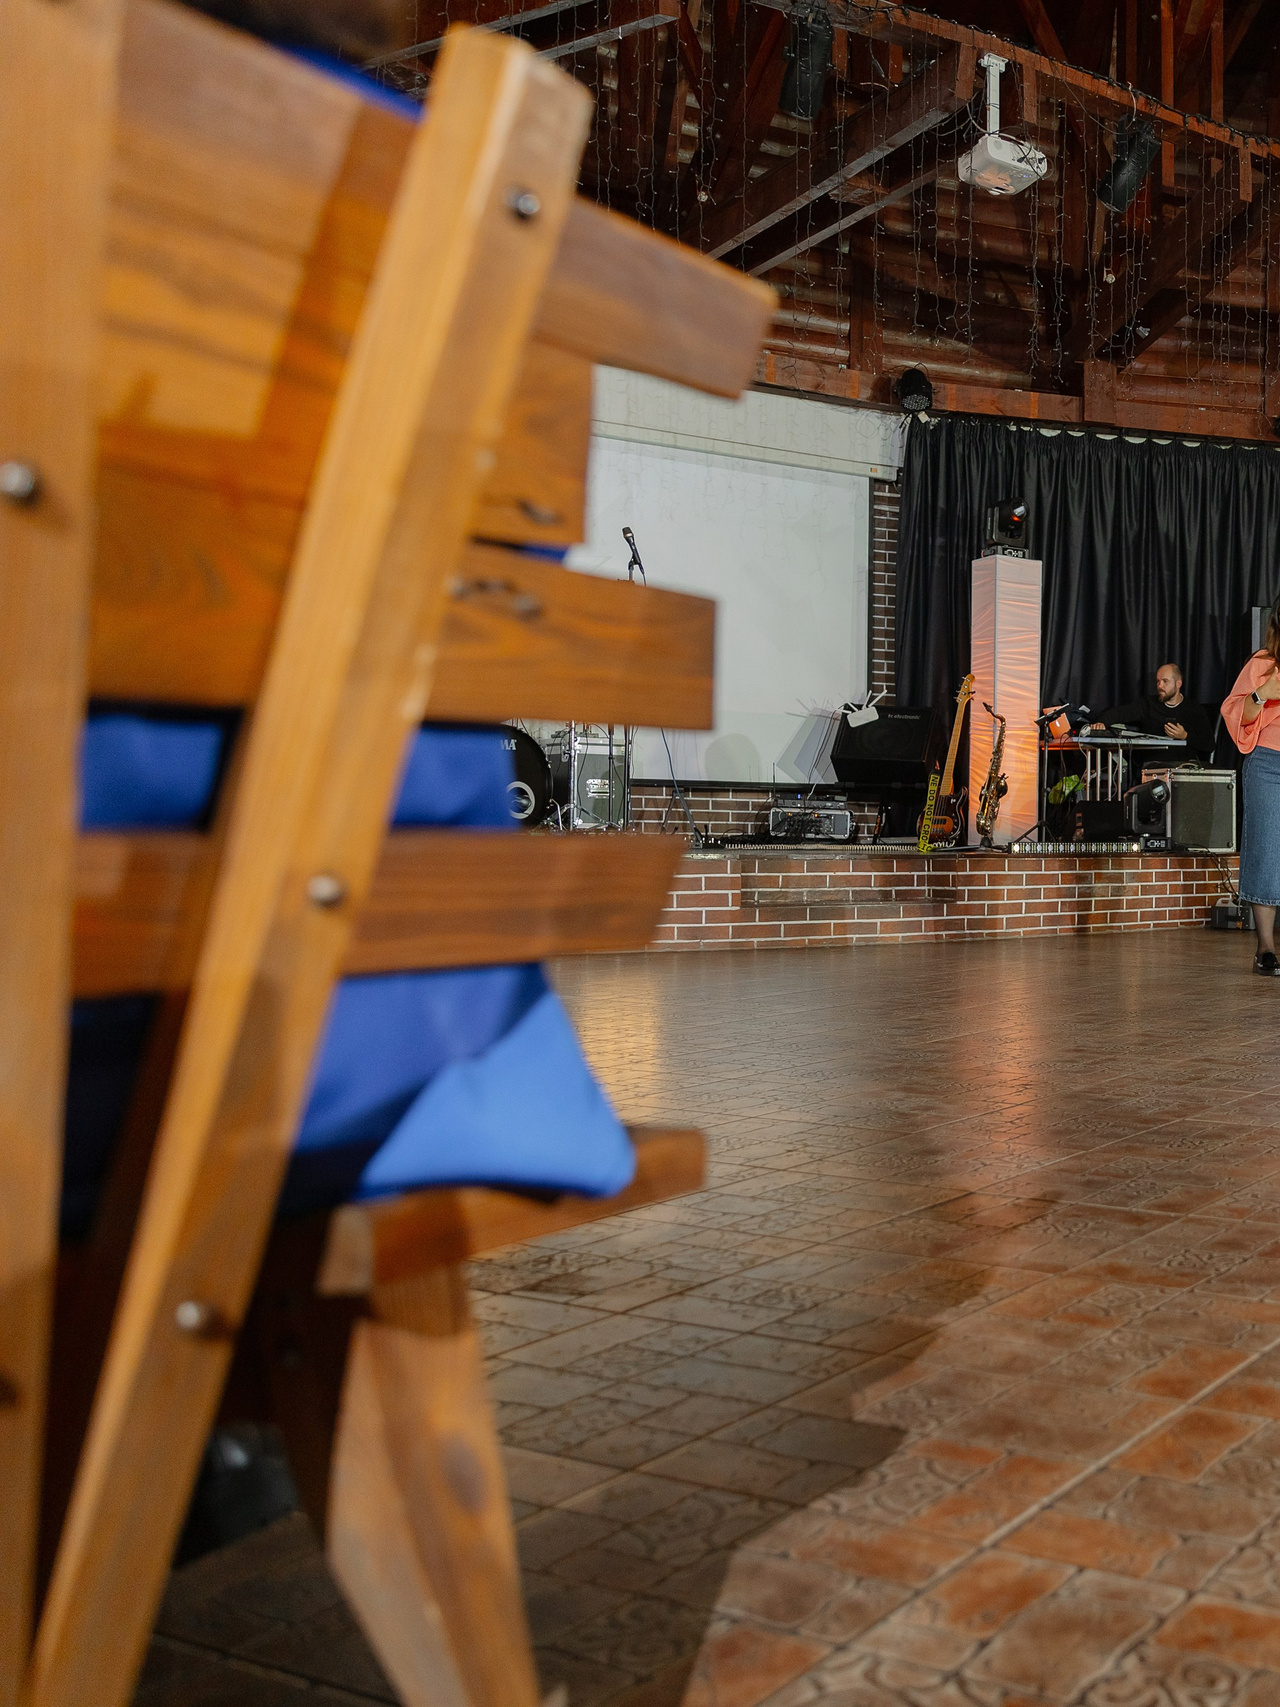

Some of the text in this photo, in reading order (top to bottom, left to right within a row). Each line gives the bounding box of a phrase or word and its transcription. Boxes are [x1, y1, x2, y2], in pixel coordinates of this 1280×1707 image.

[500, 739, 517, 750] MA
[929, 776, 939, 787] NE
[928, 789, 936, 801] DO
[925, 803, 934, 821] NOT
[921, 823, 931, 843] CRO
